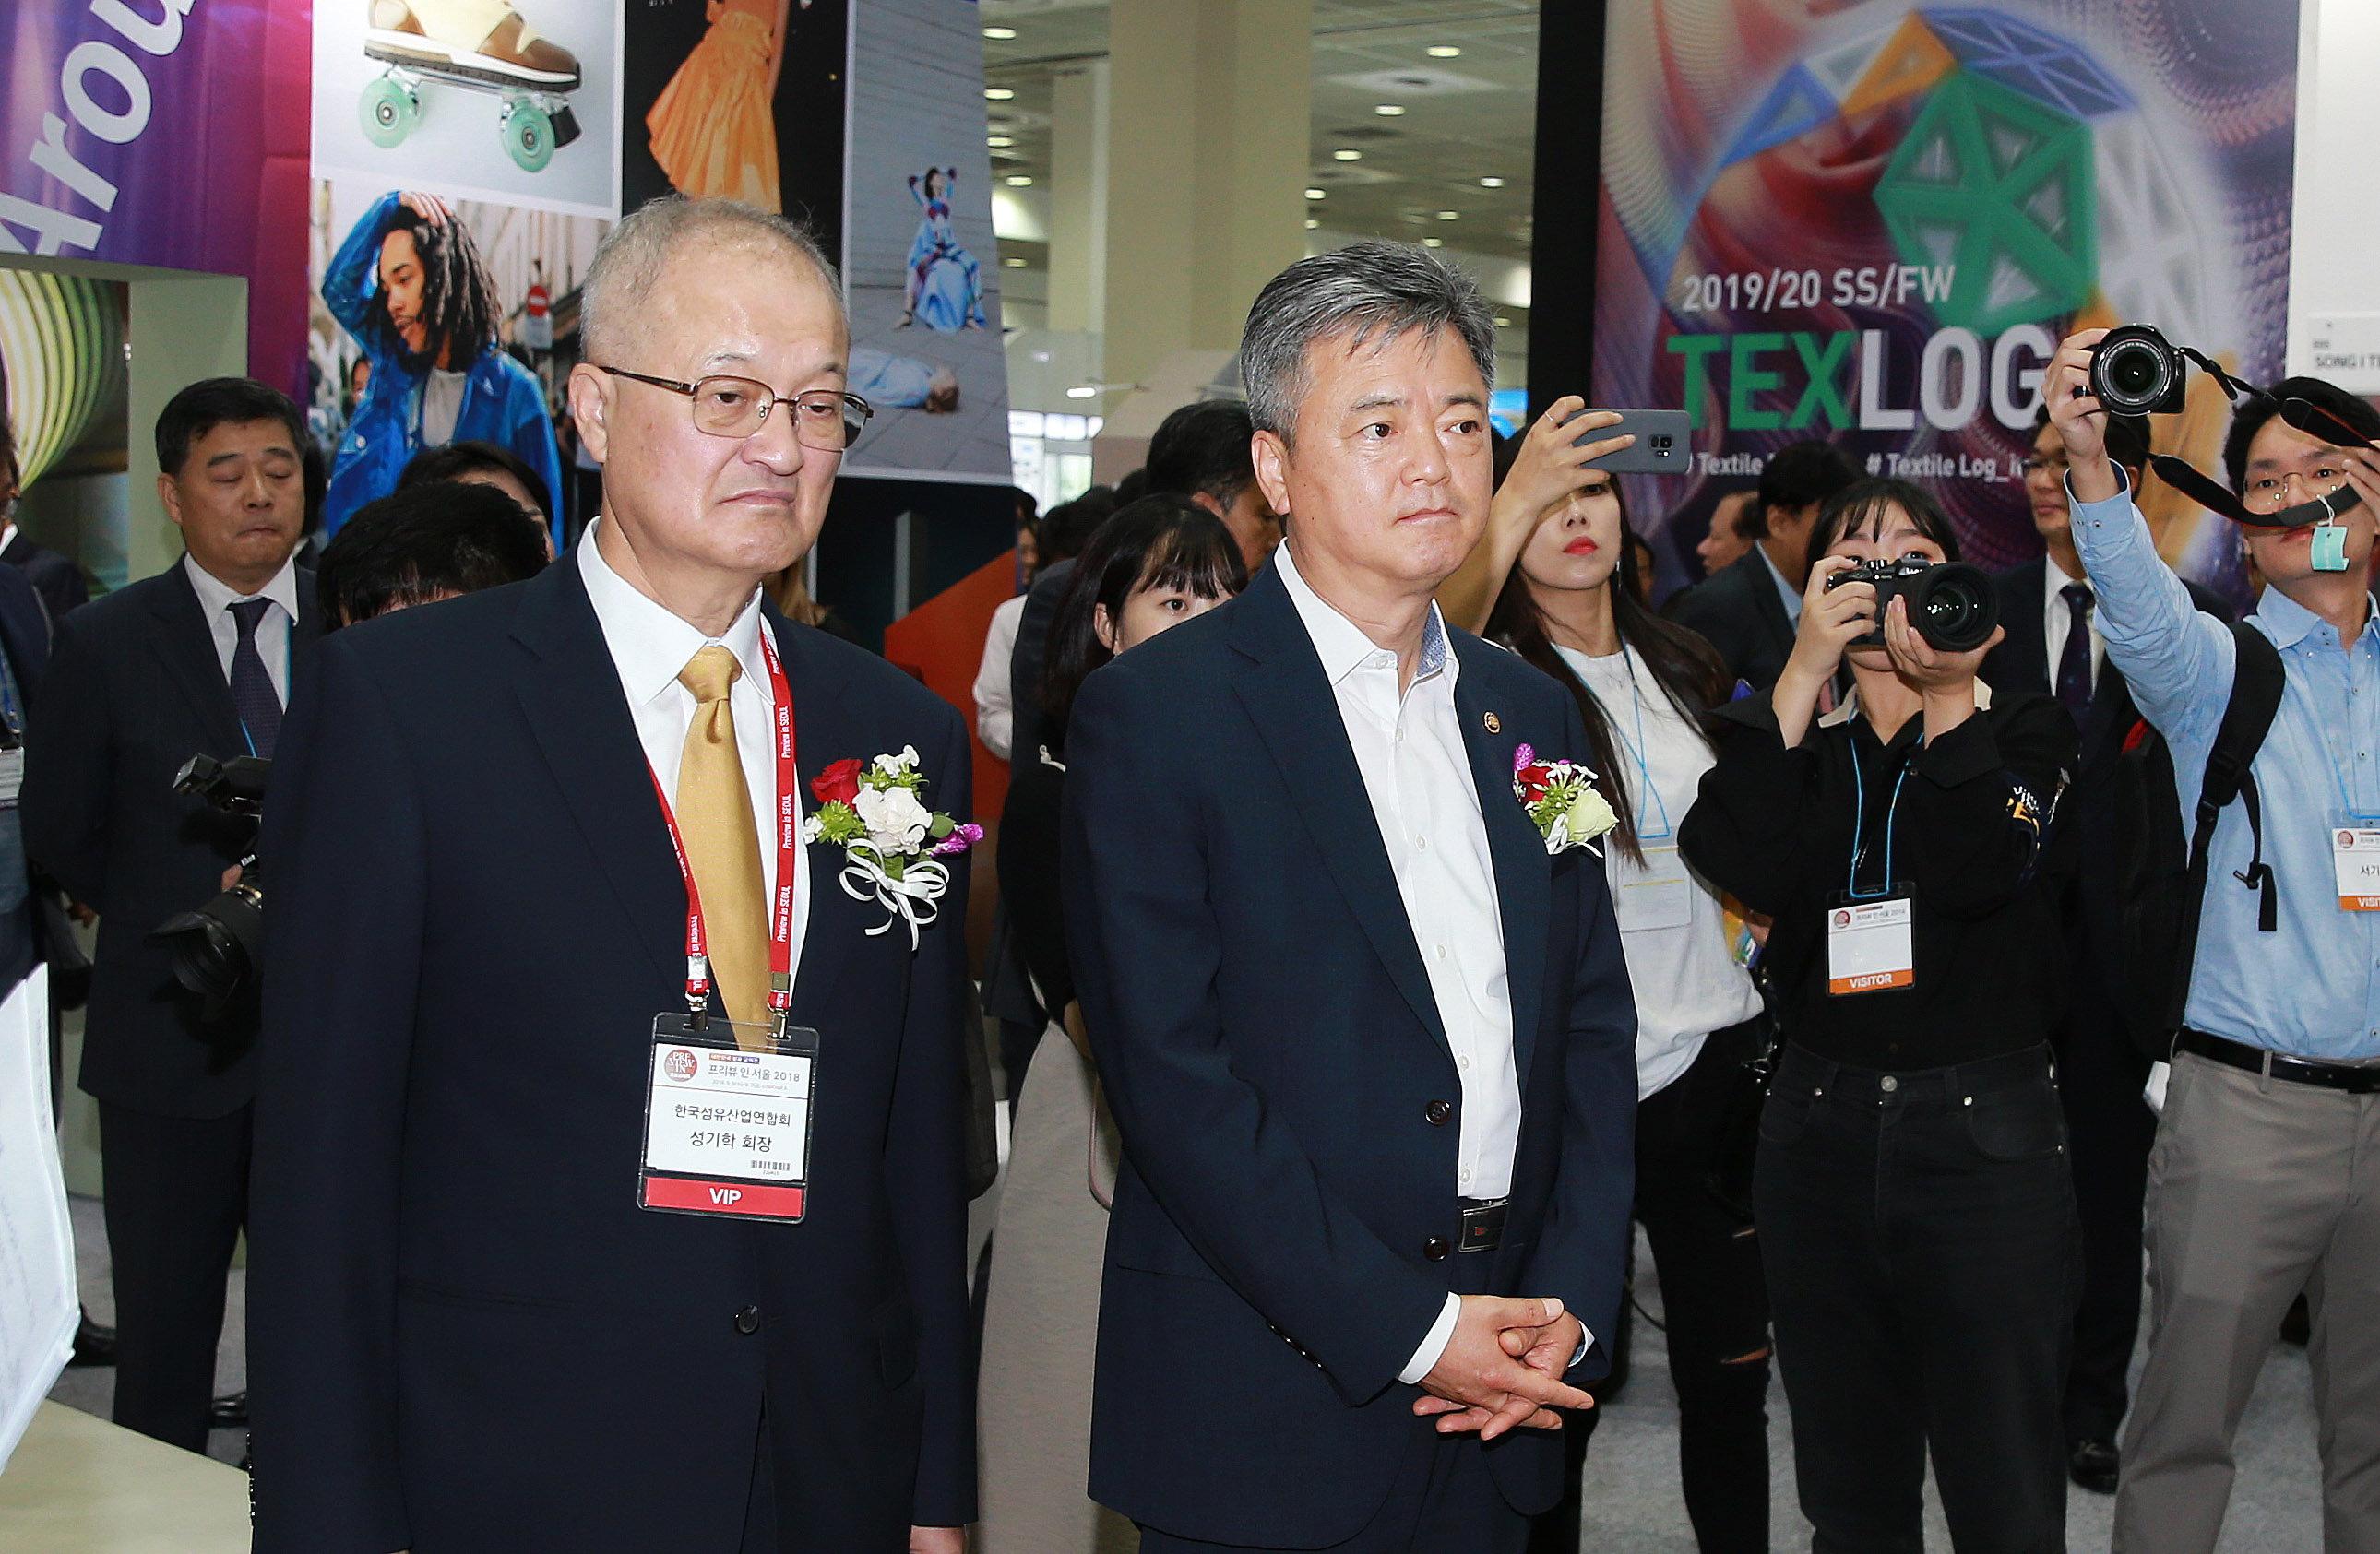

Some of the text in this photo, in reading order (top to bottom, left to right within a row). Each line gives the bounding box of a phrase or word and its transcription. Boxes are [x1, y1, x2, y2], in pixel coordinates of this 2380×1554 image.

[1683, 262, 1956, 313] 2019/20 SS/FW
[1696, 452, 1765, 476] Textile
[1865, 453, 1882, 477] #
[1886, 453, 1956, 477] Textile
[779, 706, 789, 726] SEOUL
[782, 794, 791, 815] SEOUL
[780, 886, 791, 907] SEOUL
[777, 916, 788, 942] Preview
[1849, 973, 1893, 989] VISITOR
[708, 1064, 800, 1082] 프리뷰 인 서울 2018
[674, 1104, 791, 1127] 한국섬유산업연합회
[690, 1131, 772, 1153] 성기학 회장
[709, 1187, 742, 1205] VIP
